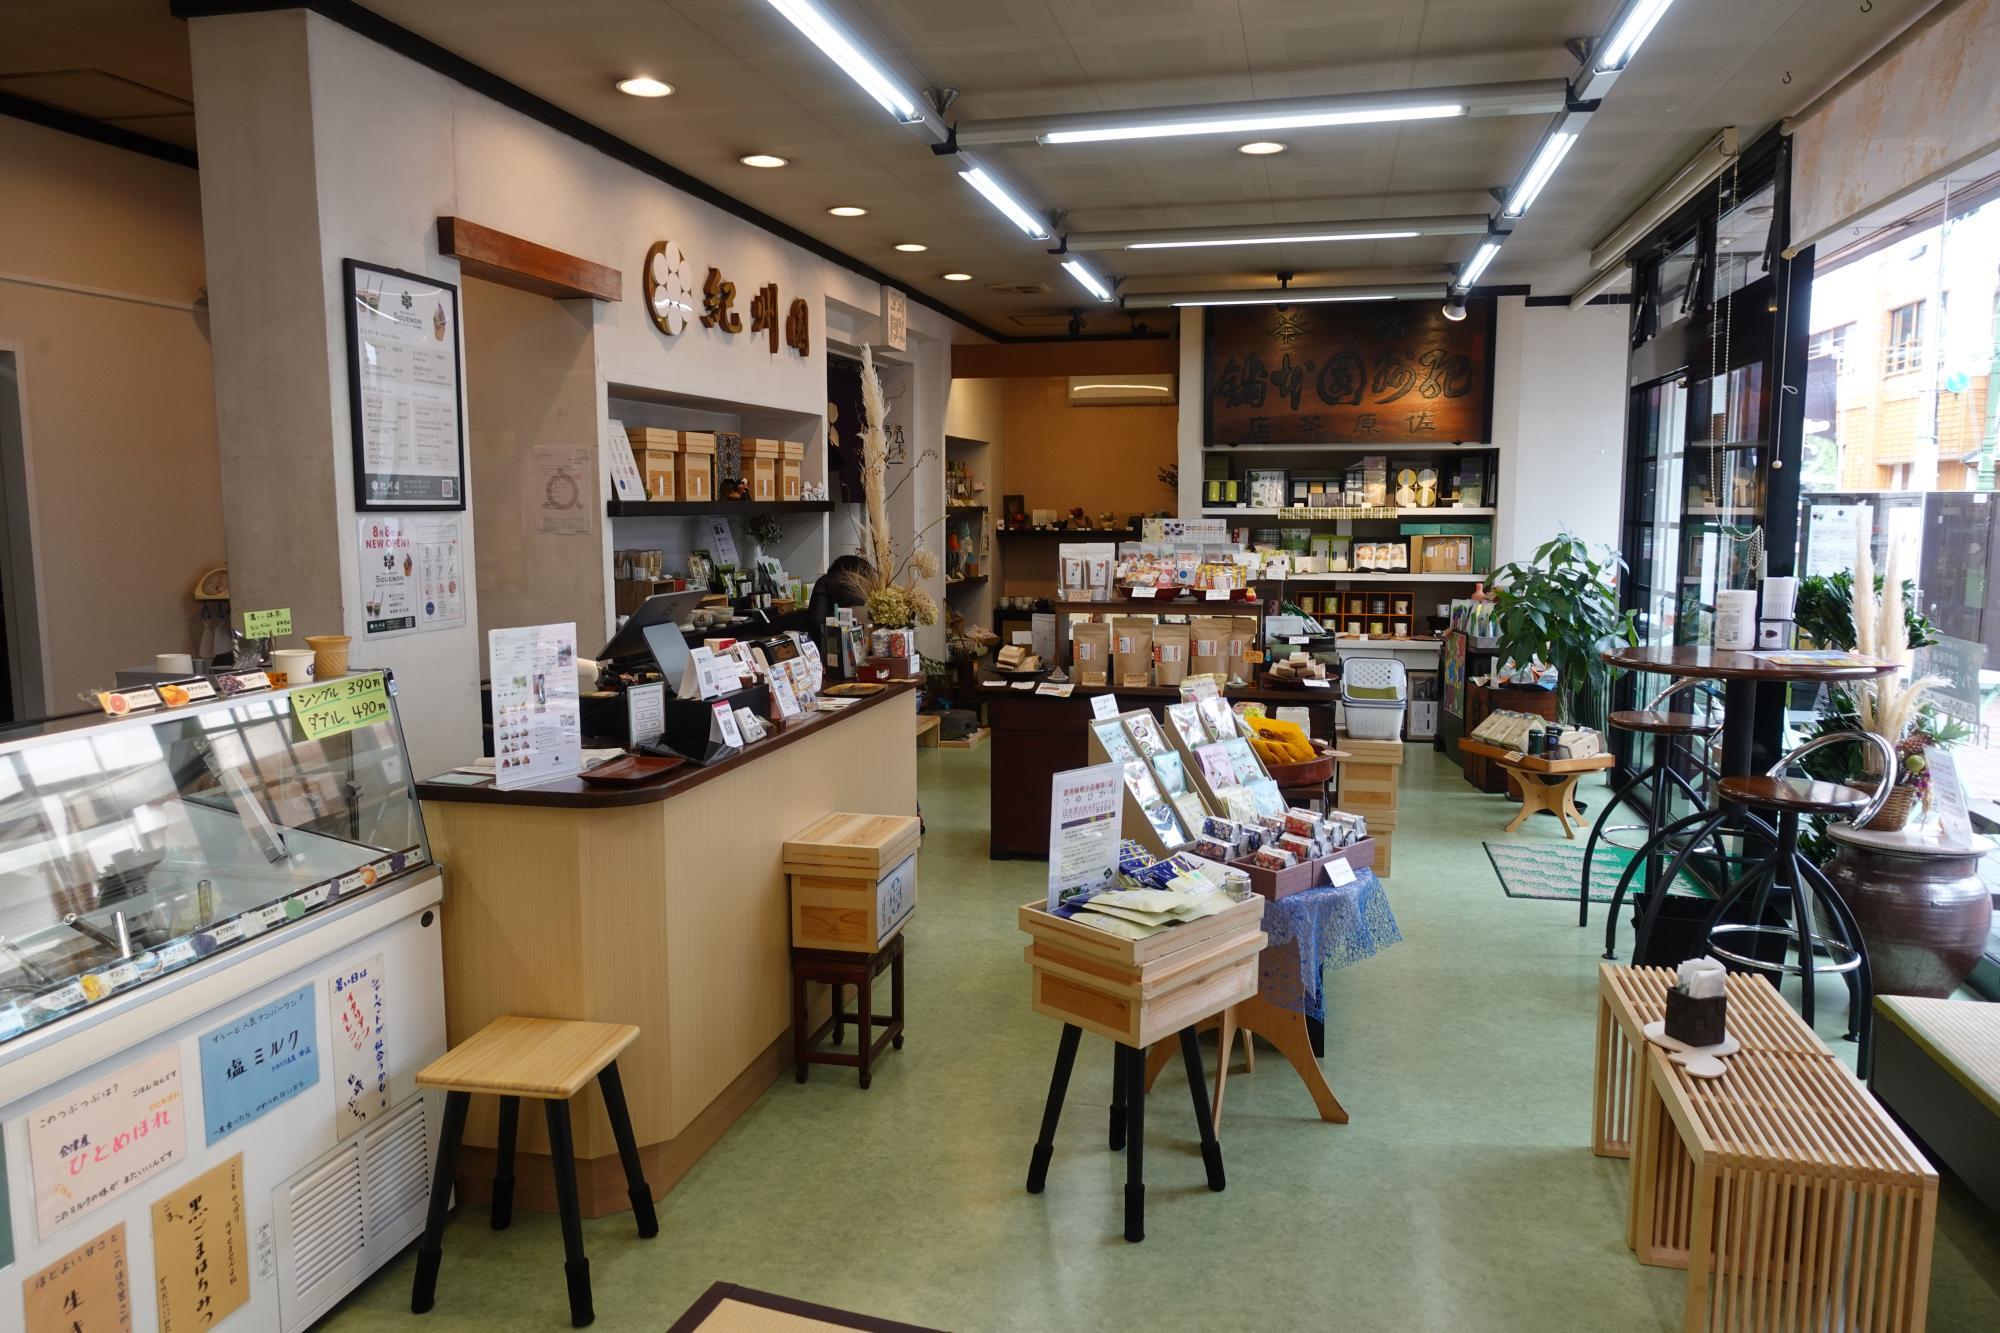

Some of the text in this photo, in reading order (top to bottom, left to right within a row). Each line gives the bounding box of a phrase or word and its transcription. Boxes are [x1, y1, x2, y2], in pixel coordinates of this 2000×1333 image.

[364, 538, 384, 550] NEW
[299, 678, 380, 708] シングル 390円
[308, 701, 386, 731] ダブル 490円
[1063, 787, 1116, 806] つゆひかり
[110, 967, 129, 978] マンゴー
[334, 968, 368, 994] 暑い日は
[340, 1012, 362, 1051] オレンジ
[346, 991, 370, 1039] イタリアン
[224, 1029, 299, 1083] 塩ミルク
[39, 1082, 119, 1129] このつぶつぶは?
[35, 1234, 118, 1290] ほどよい甘さと
[187, 1193, 214, 1324] 黒ごまはちみつ
